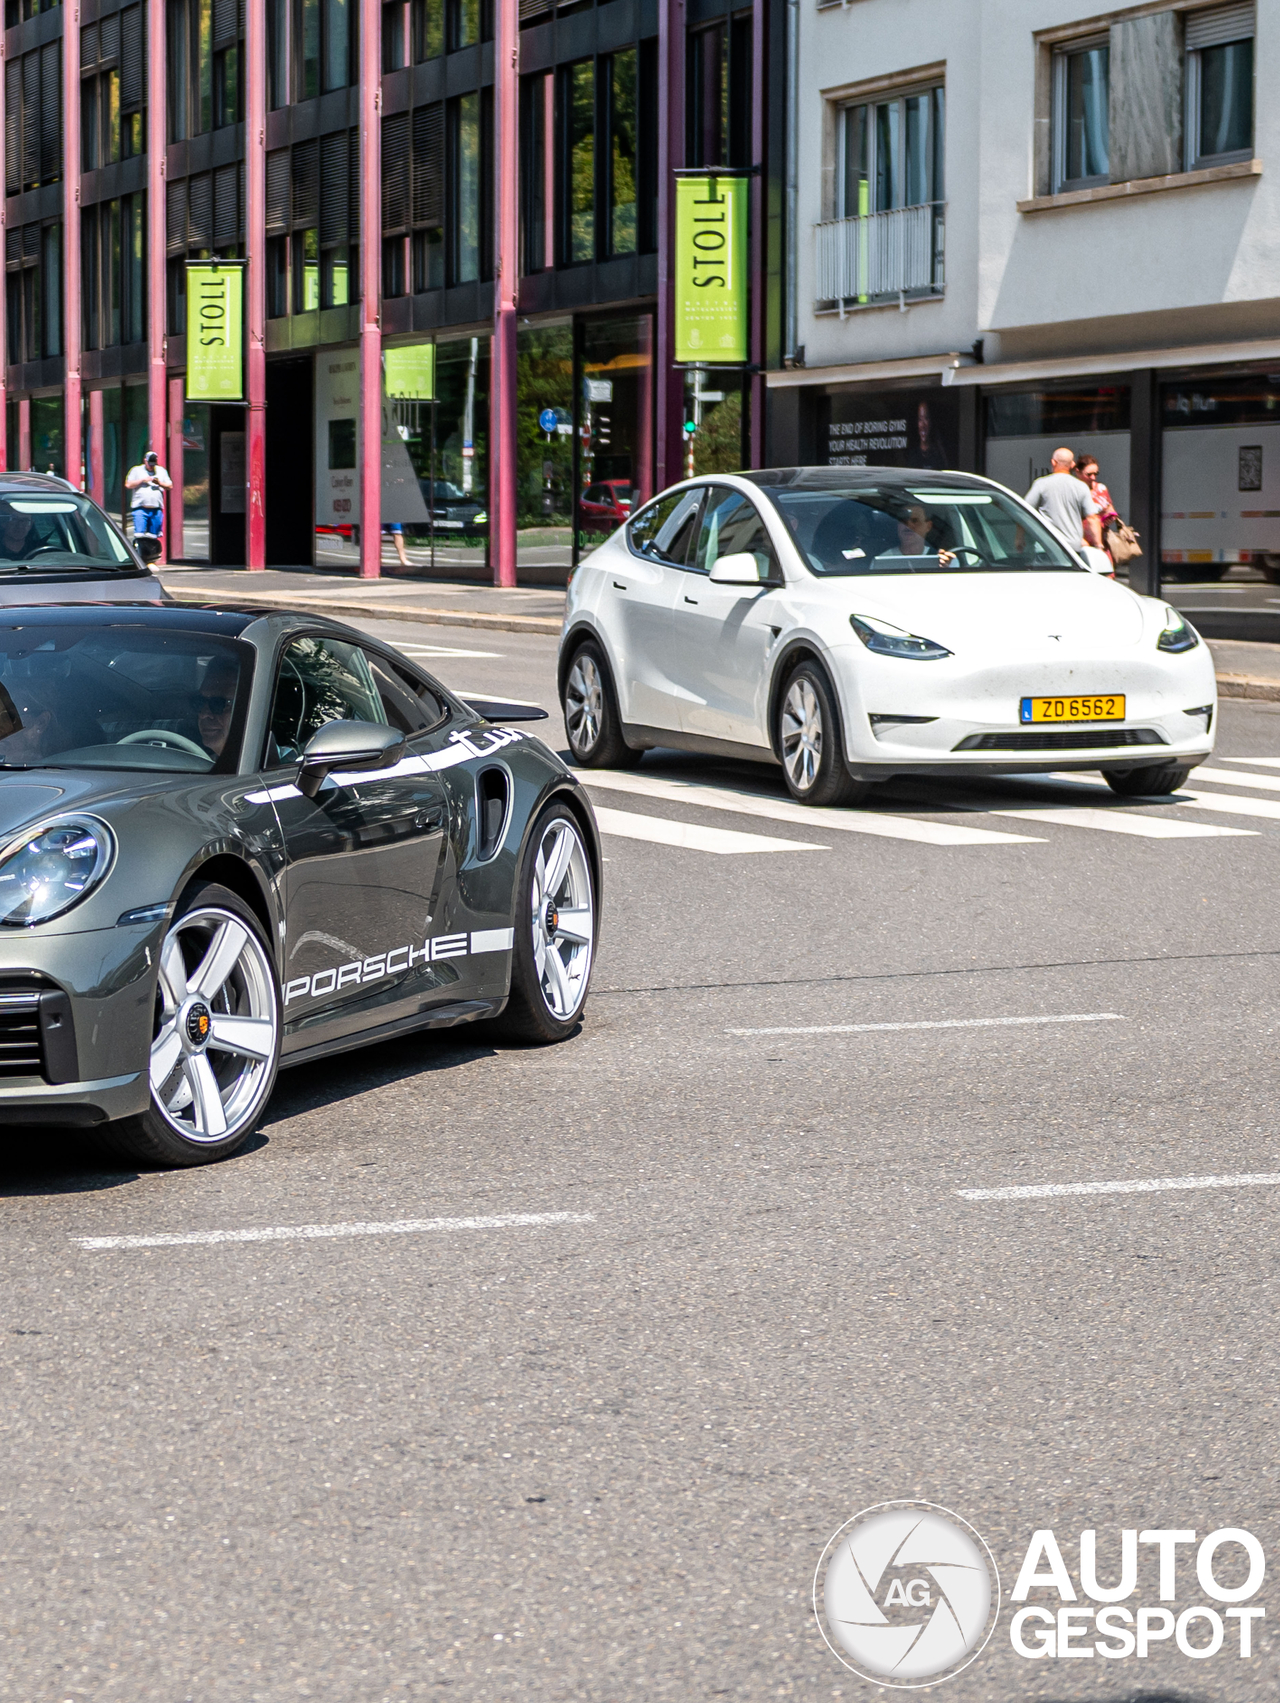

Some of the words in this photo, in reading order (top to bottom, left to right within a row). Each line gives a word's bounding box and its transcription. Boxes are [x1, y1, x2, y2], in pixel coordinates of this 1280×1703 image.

[692, 193, 726, 288] STOLL
[200, 278, 226, 347] STOLL
[828, 439, 845, 452] YOUR
[845, 438, 868, 451] HEALTH
[868, 436, 908, 450] REVOLUTION
[841, 422, 854, 436] END
[854, 421, 863, 434] OF
[863, 420, 888, 434] BORING
[888, 418, 907, 432] GYMS
[1042, 700, 1064, 718] ZD
[1069, 698, 1115, 717] 6562
[284, 932, 468, 1006] PORSCHE
